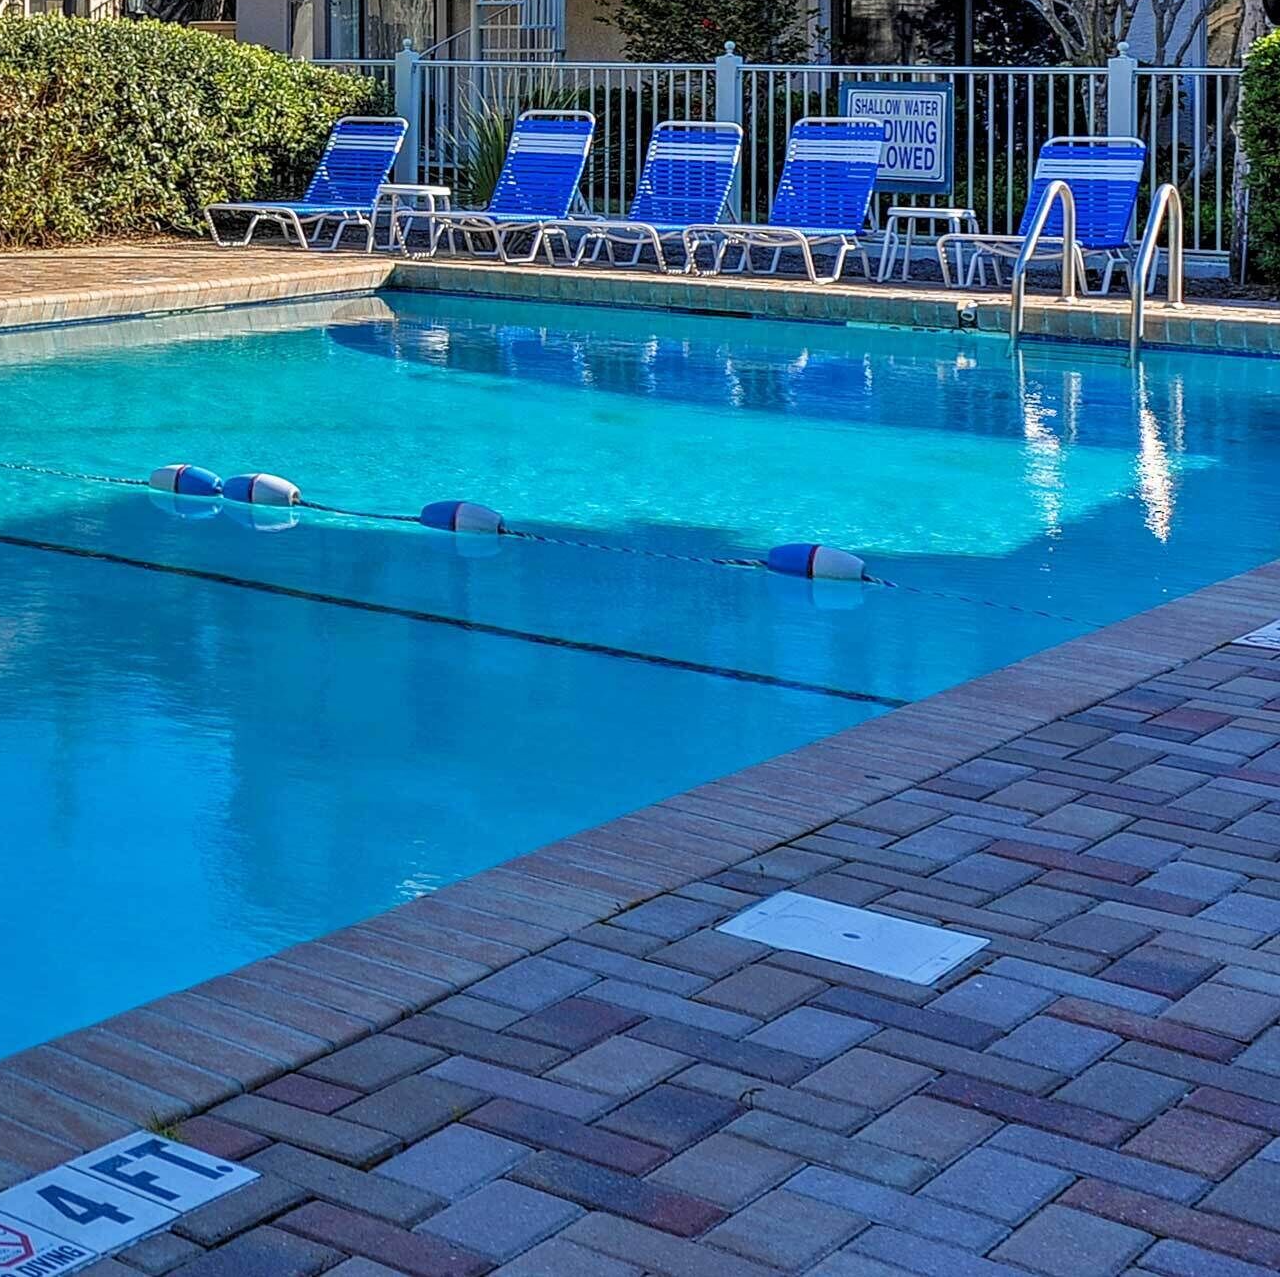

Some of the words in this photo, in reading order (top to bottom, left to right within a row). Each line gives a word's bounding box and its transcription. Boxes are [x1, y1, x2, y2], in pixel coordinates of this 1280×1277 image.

[854, 98, 900, 115] SHALLOW
[905, 100, 938, 117] WATER
[883, 119, 937, 145] DIVING
[36, 1184, 135, 1225] 4
[89, 1138, 234, 1202] FT.
